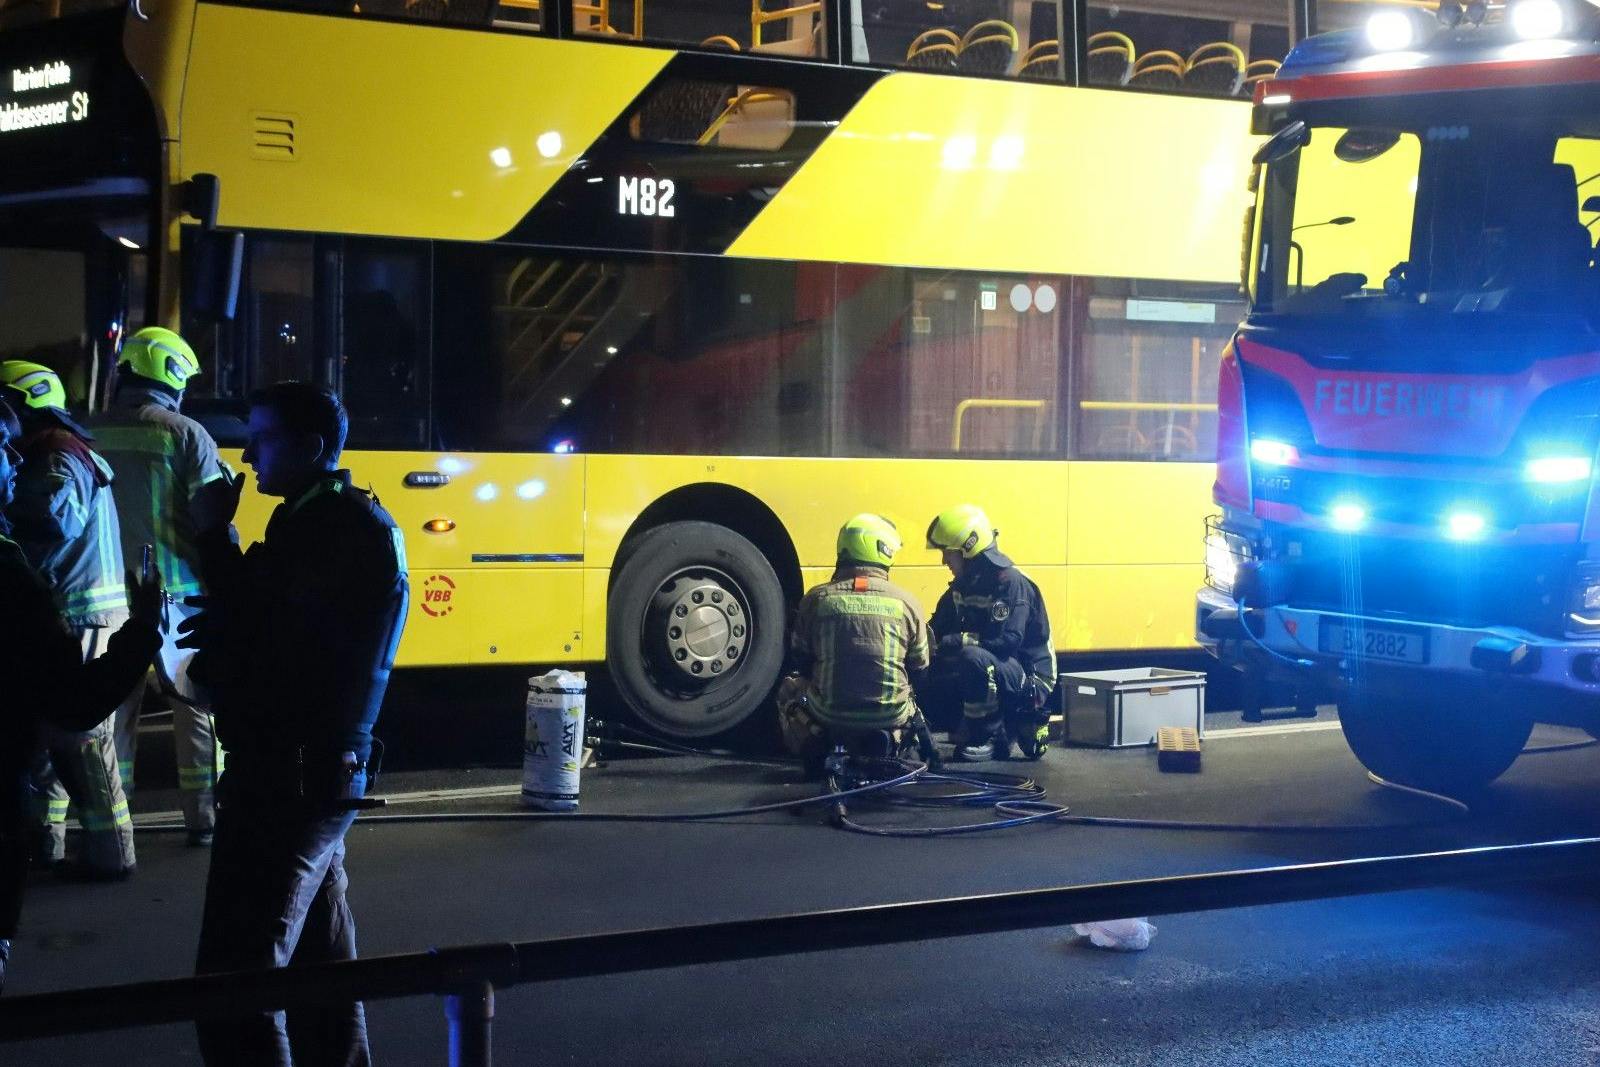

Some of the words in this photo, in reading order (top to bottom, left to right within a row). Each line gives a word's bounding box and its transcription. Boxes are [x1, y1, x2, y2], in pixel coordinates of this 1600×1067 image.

[619, 175, 675, 217] M82
[424, 590, 452, 602] VBB
[1365, 631, 1408, 657] 2882
